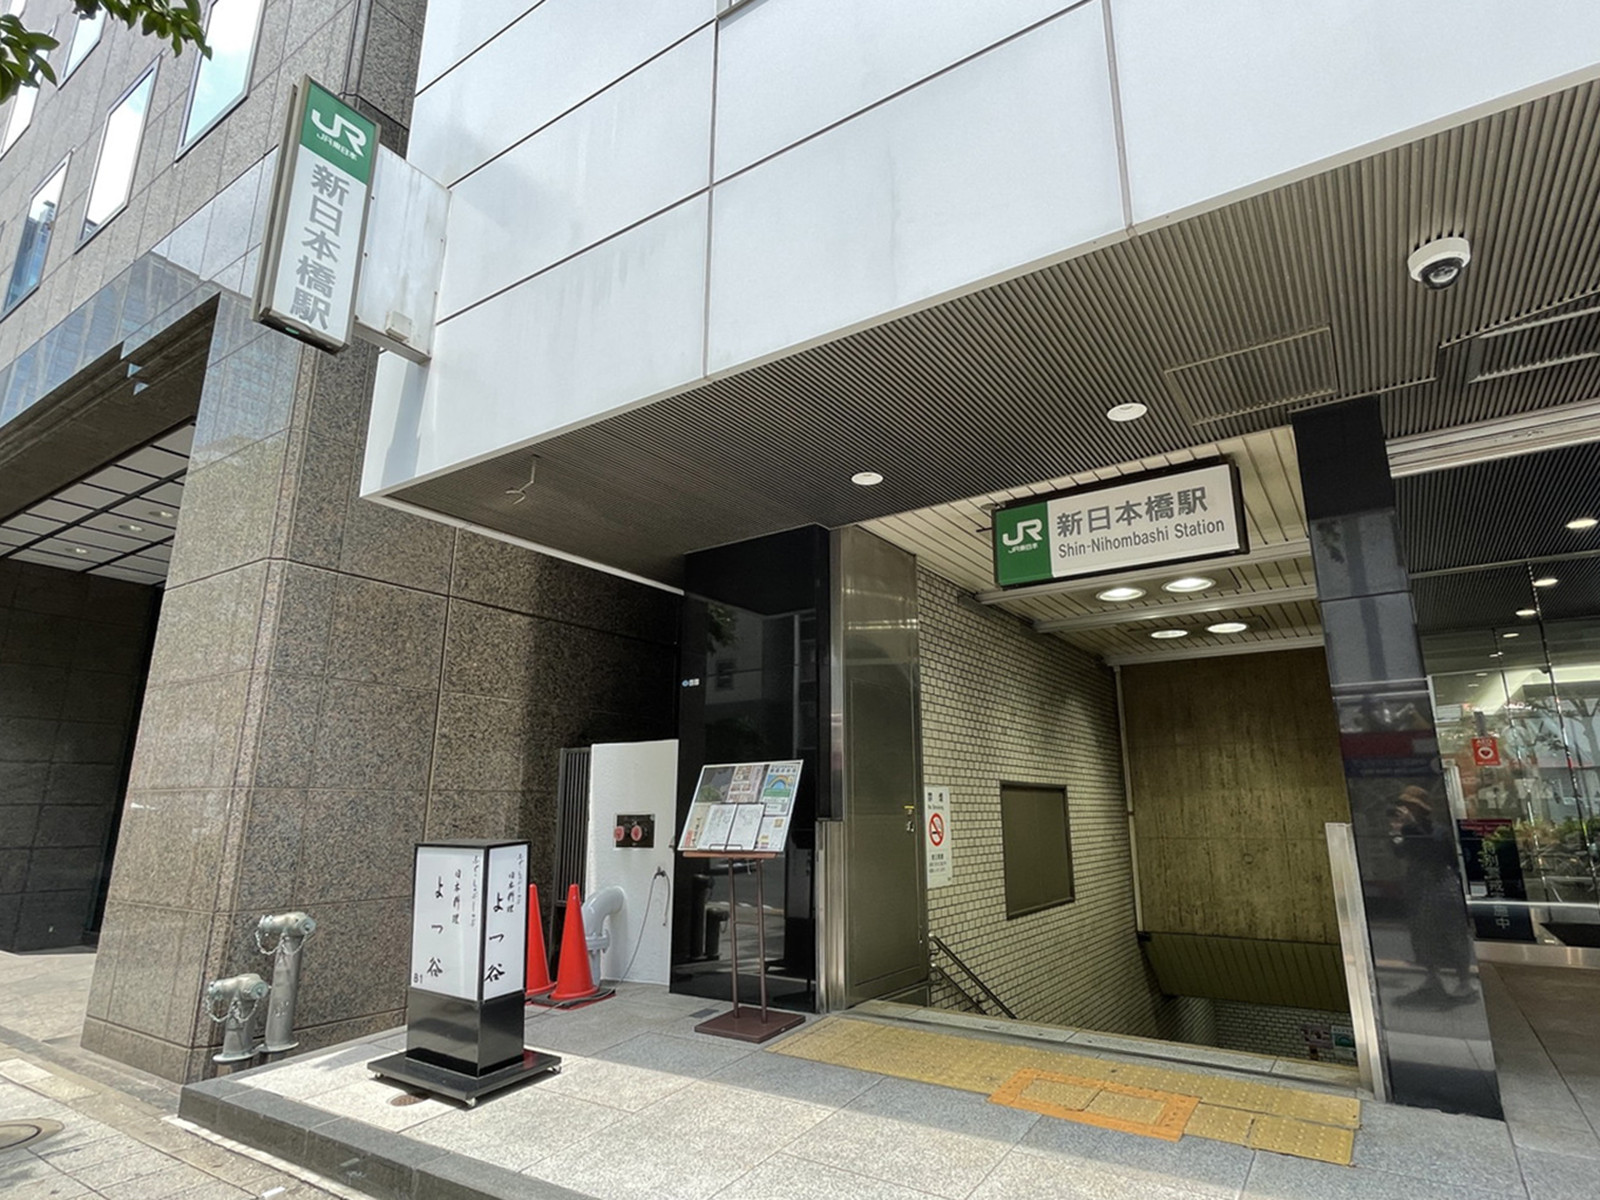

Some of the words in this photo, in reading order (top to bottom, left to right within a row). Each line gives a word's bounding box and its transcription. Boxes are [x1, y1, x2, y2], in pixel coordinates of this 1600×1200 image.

[311, 108, 367, 157] JR
[290, 163, 350, 330] 新日本橋駅
[1002, 518, 1043, 547] JR
[1056, 486, 1208, 538] 新日本橋駅
[1058, 526, 1169, 559] Shin-Nihombashi
[1174, 519, 1225, 539] Station
[452, 869, 462, 925] 日本料理
[413, 972, 423, 984] B1
